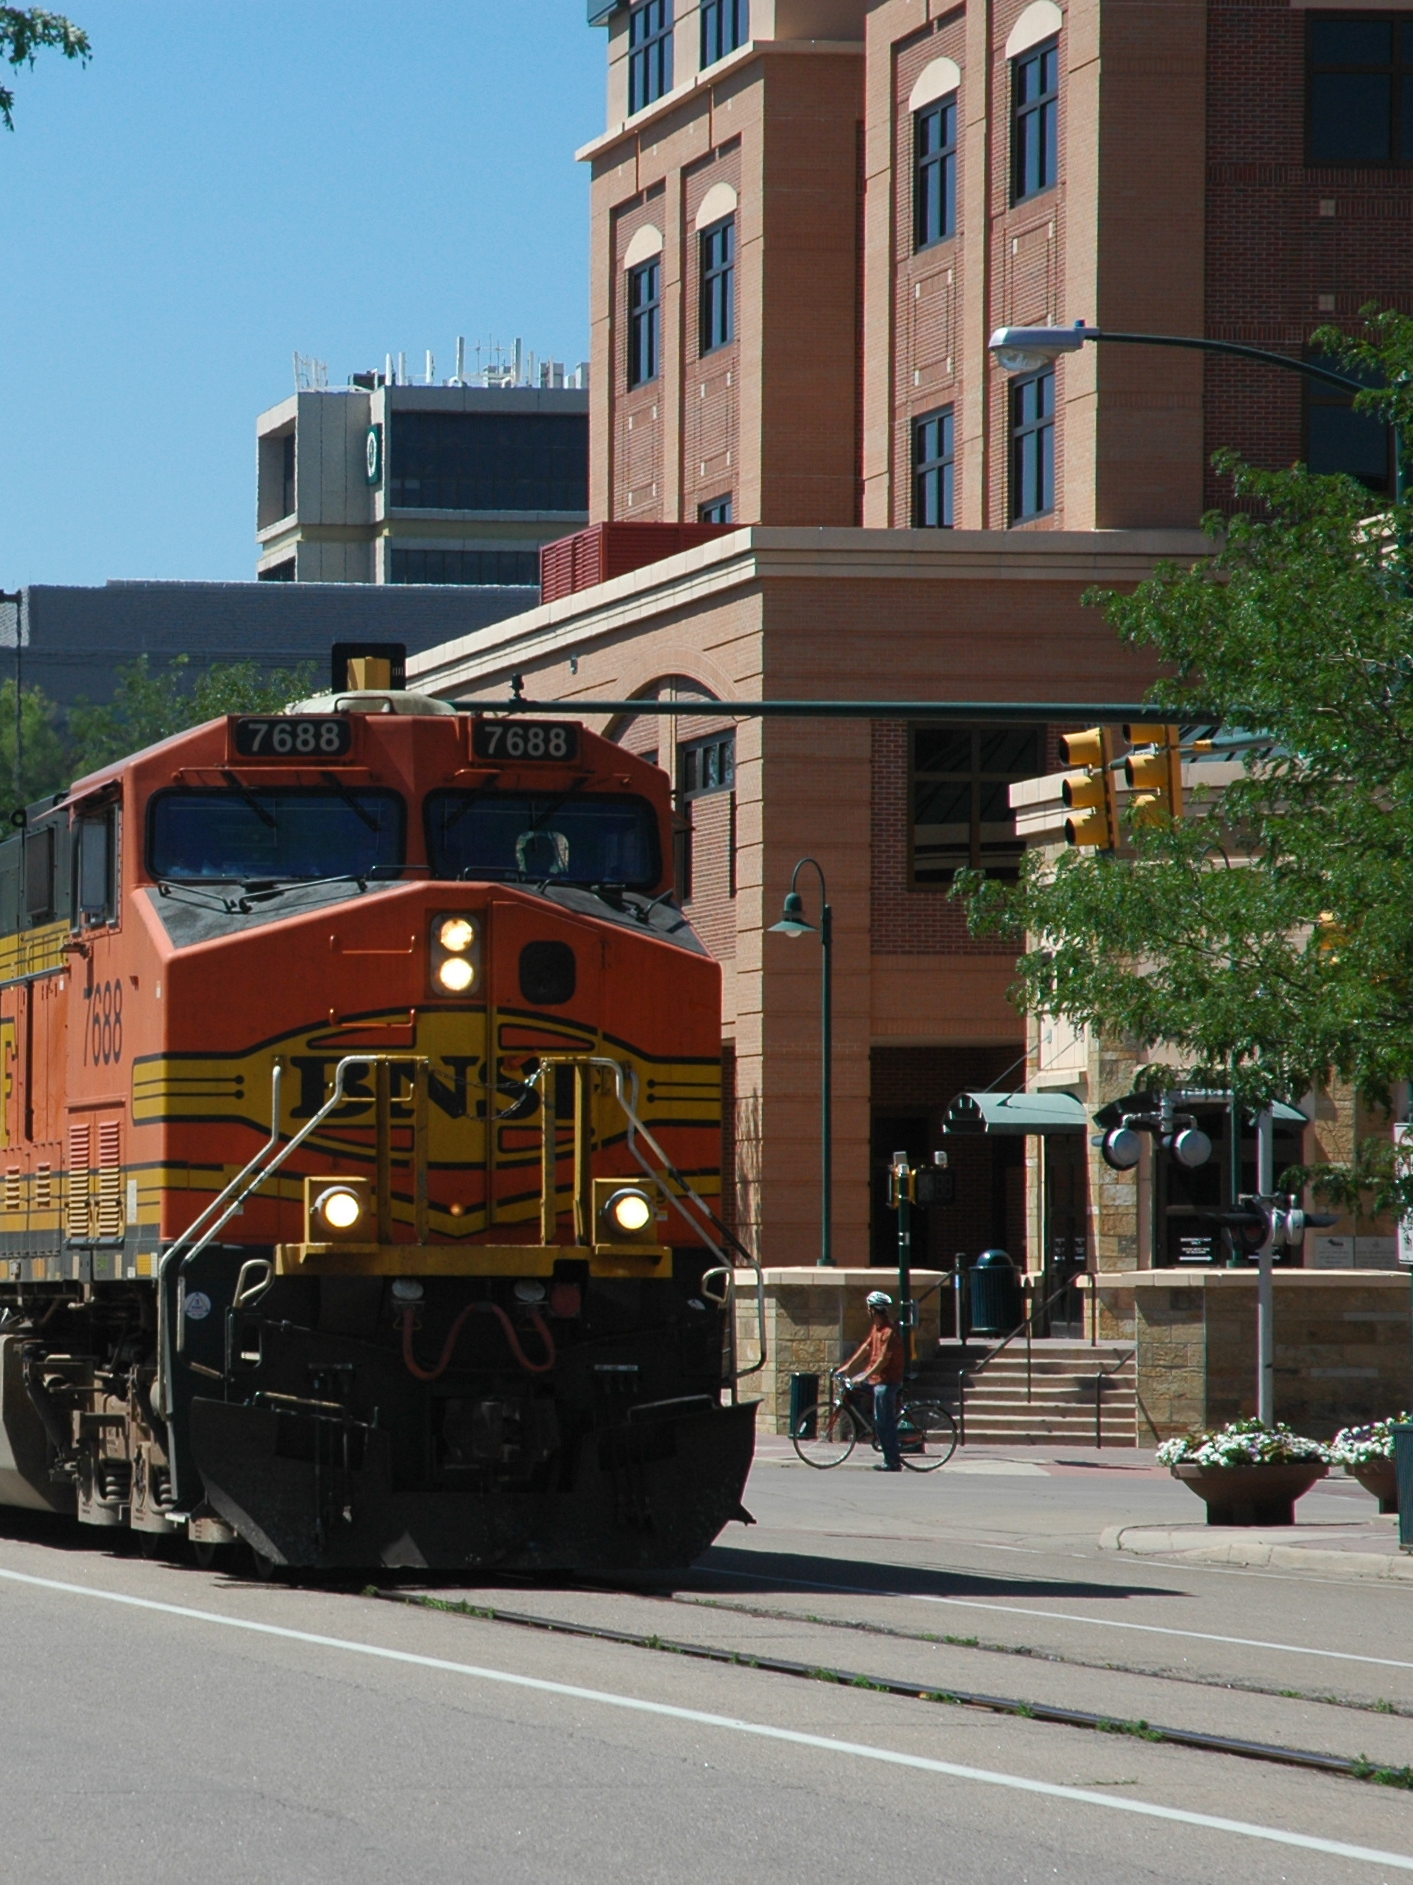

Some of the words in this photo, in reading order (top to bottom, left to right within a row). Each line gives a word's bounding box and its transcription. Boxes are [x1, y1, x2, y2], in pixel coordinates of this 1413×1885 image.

[247, 722, 341, 753] 7688
[483, 725, 568, 757] 7688
[83, 977, 123, 1067] 7688
